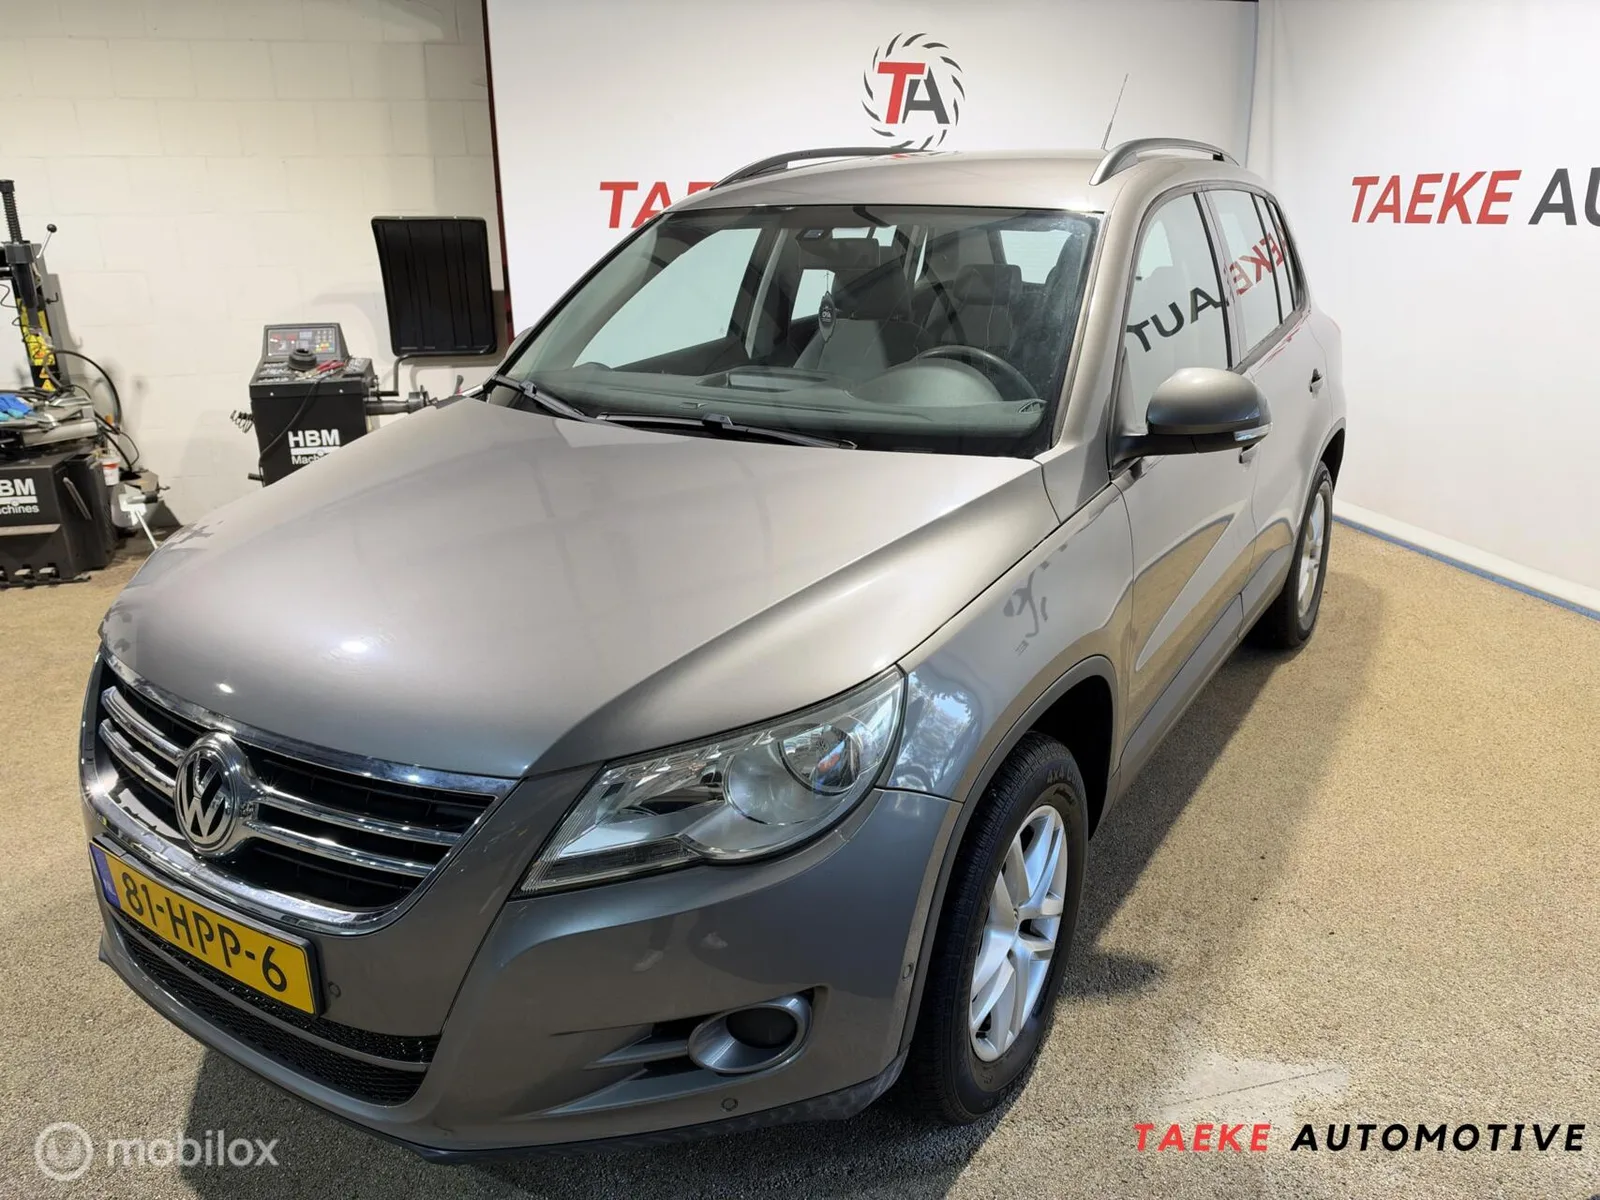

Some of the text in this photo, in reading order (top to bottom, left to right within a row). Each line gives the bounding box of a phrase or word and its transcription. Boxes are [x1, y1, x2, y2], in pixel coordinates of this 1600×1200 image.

[877, 61, 950, 125] TA
[1351, 169, 1523, 225] TAEKE
[287, 428, 341, 448] HBM
[121, 871, 288, 993] 81-HPP-6
